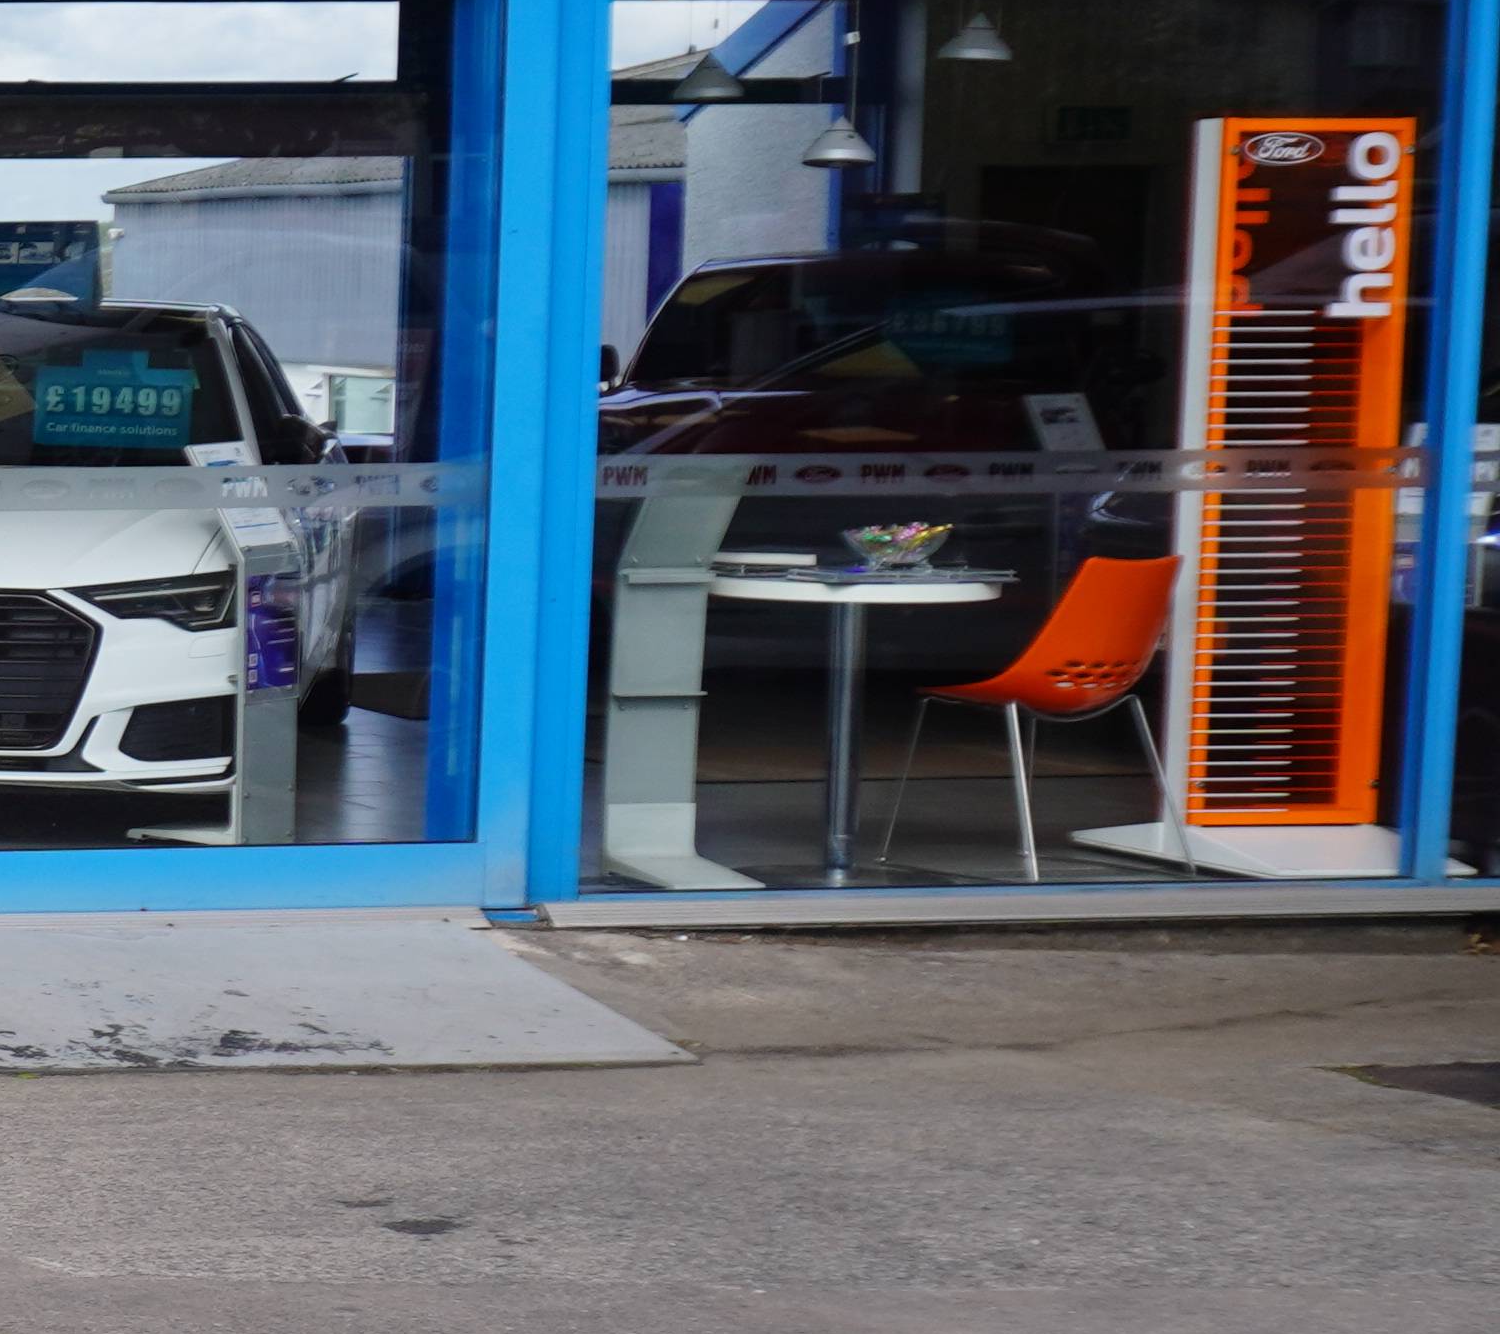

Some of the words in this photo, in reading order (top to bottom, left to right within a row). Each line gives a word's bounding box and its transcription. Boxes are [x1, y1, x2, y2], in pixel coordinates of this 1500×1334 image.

[1324, 131, 1401, 318] hello
[45, 384, 182, 417] £19499
[46, 422, 68, 433] Car
[70, 422, 117, 435] finance
[120, 424, 178, 436] solutions
[221, 476, 269, 498] PWM
[602, 465, 648, 487] PWM
[861, 464, 906, 484] PWM
[988, 461, 1035, 479] PWM
